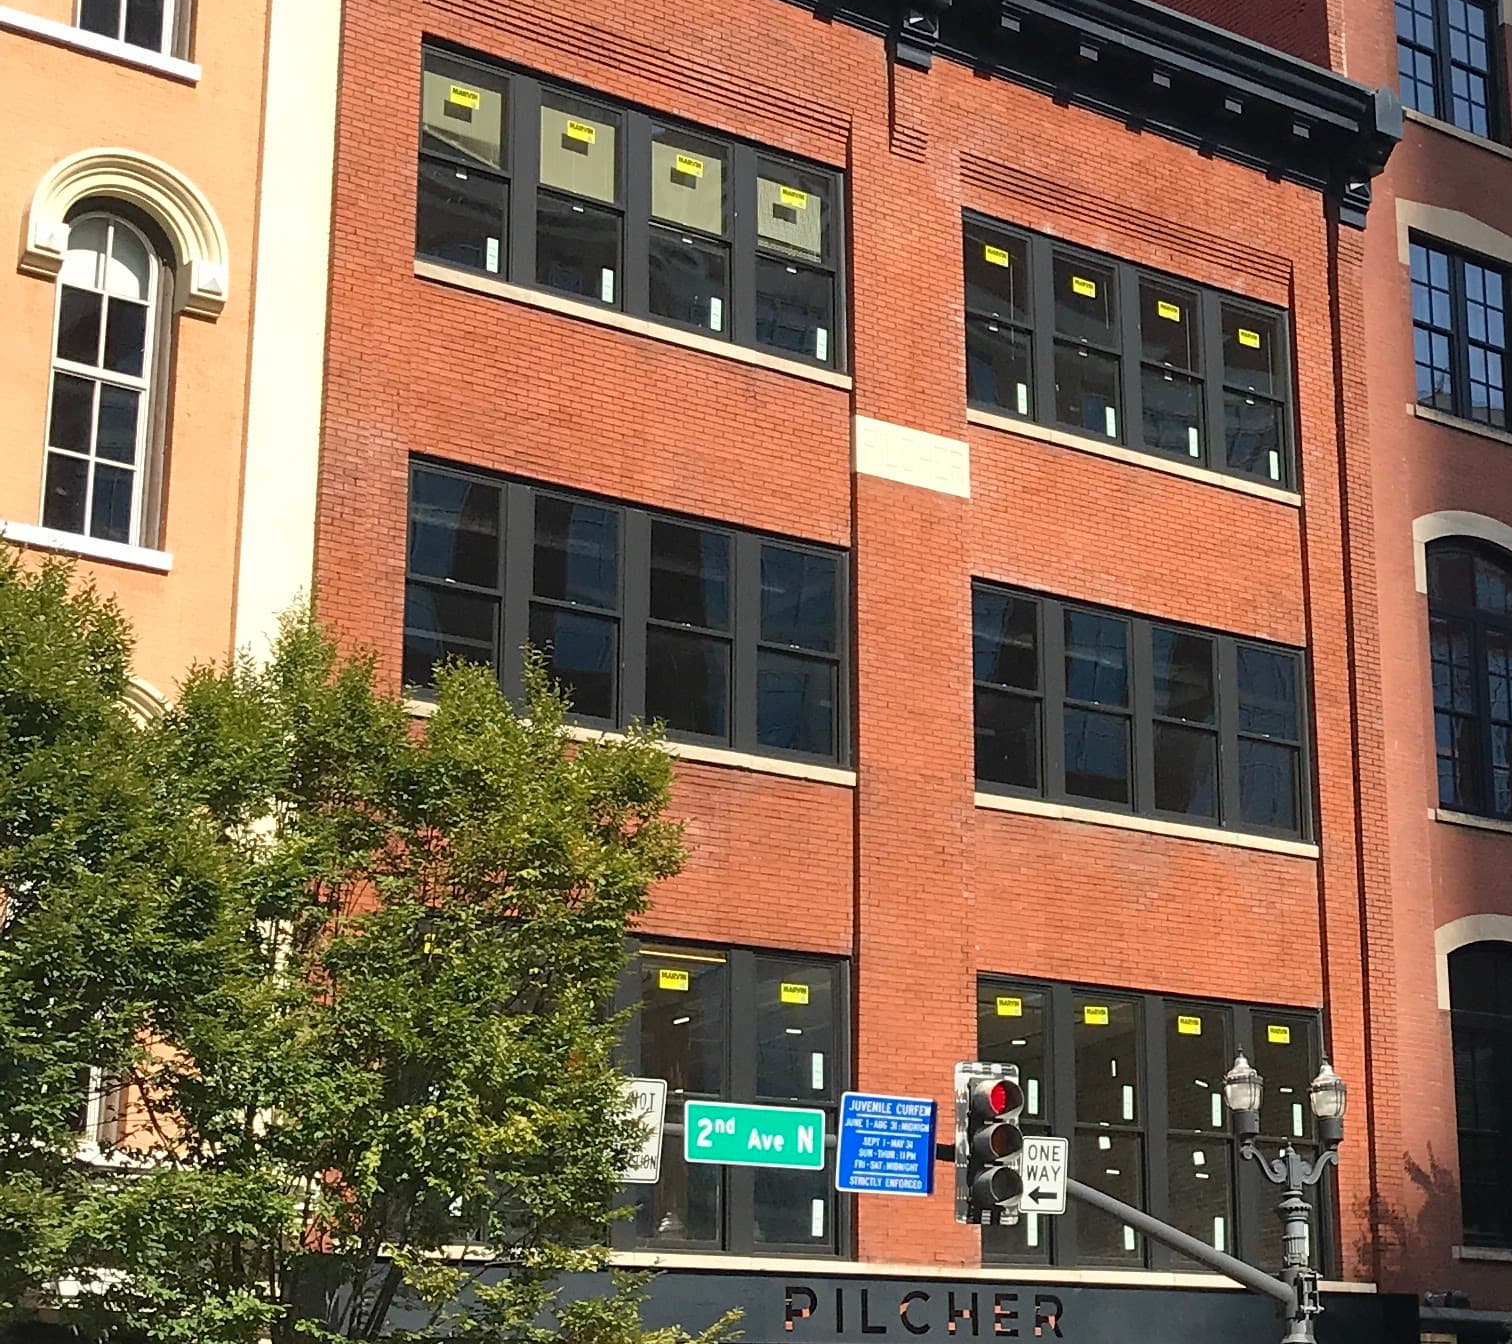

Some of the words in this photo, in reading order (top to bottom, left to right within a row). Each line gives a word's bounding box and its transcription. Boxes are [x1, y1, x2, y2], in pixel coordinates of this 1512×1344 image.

[848, 1100, 893, 1114] JUVENILE
[696, 1117, 736, 1148] 2nd
[747, 1128, 785, 1152] Ave
[797, 1125, 814, 1154] N
[1028, 1144, 1061, 1162] ONE
[1027, 1165, 1061, 1182] WAY
[849, 1176, 883, 1187] STRICTLY
[885, 1178, 922, 1189] ENFORCED
[785, 1286, 1064, 1338] PILCHER
